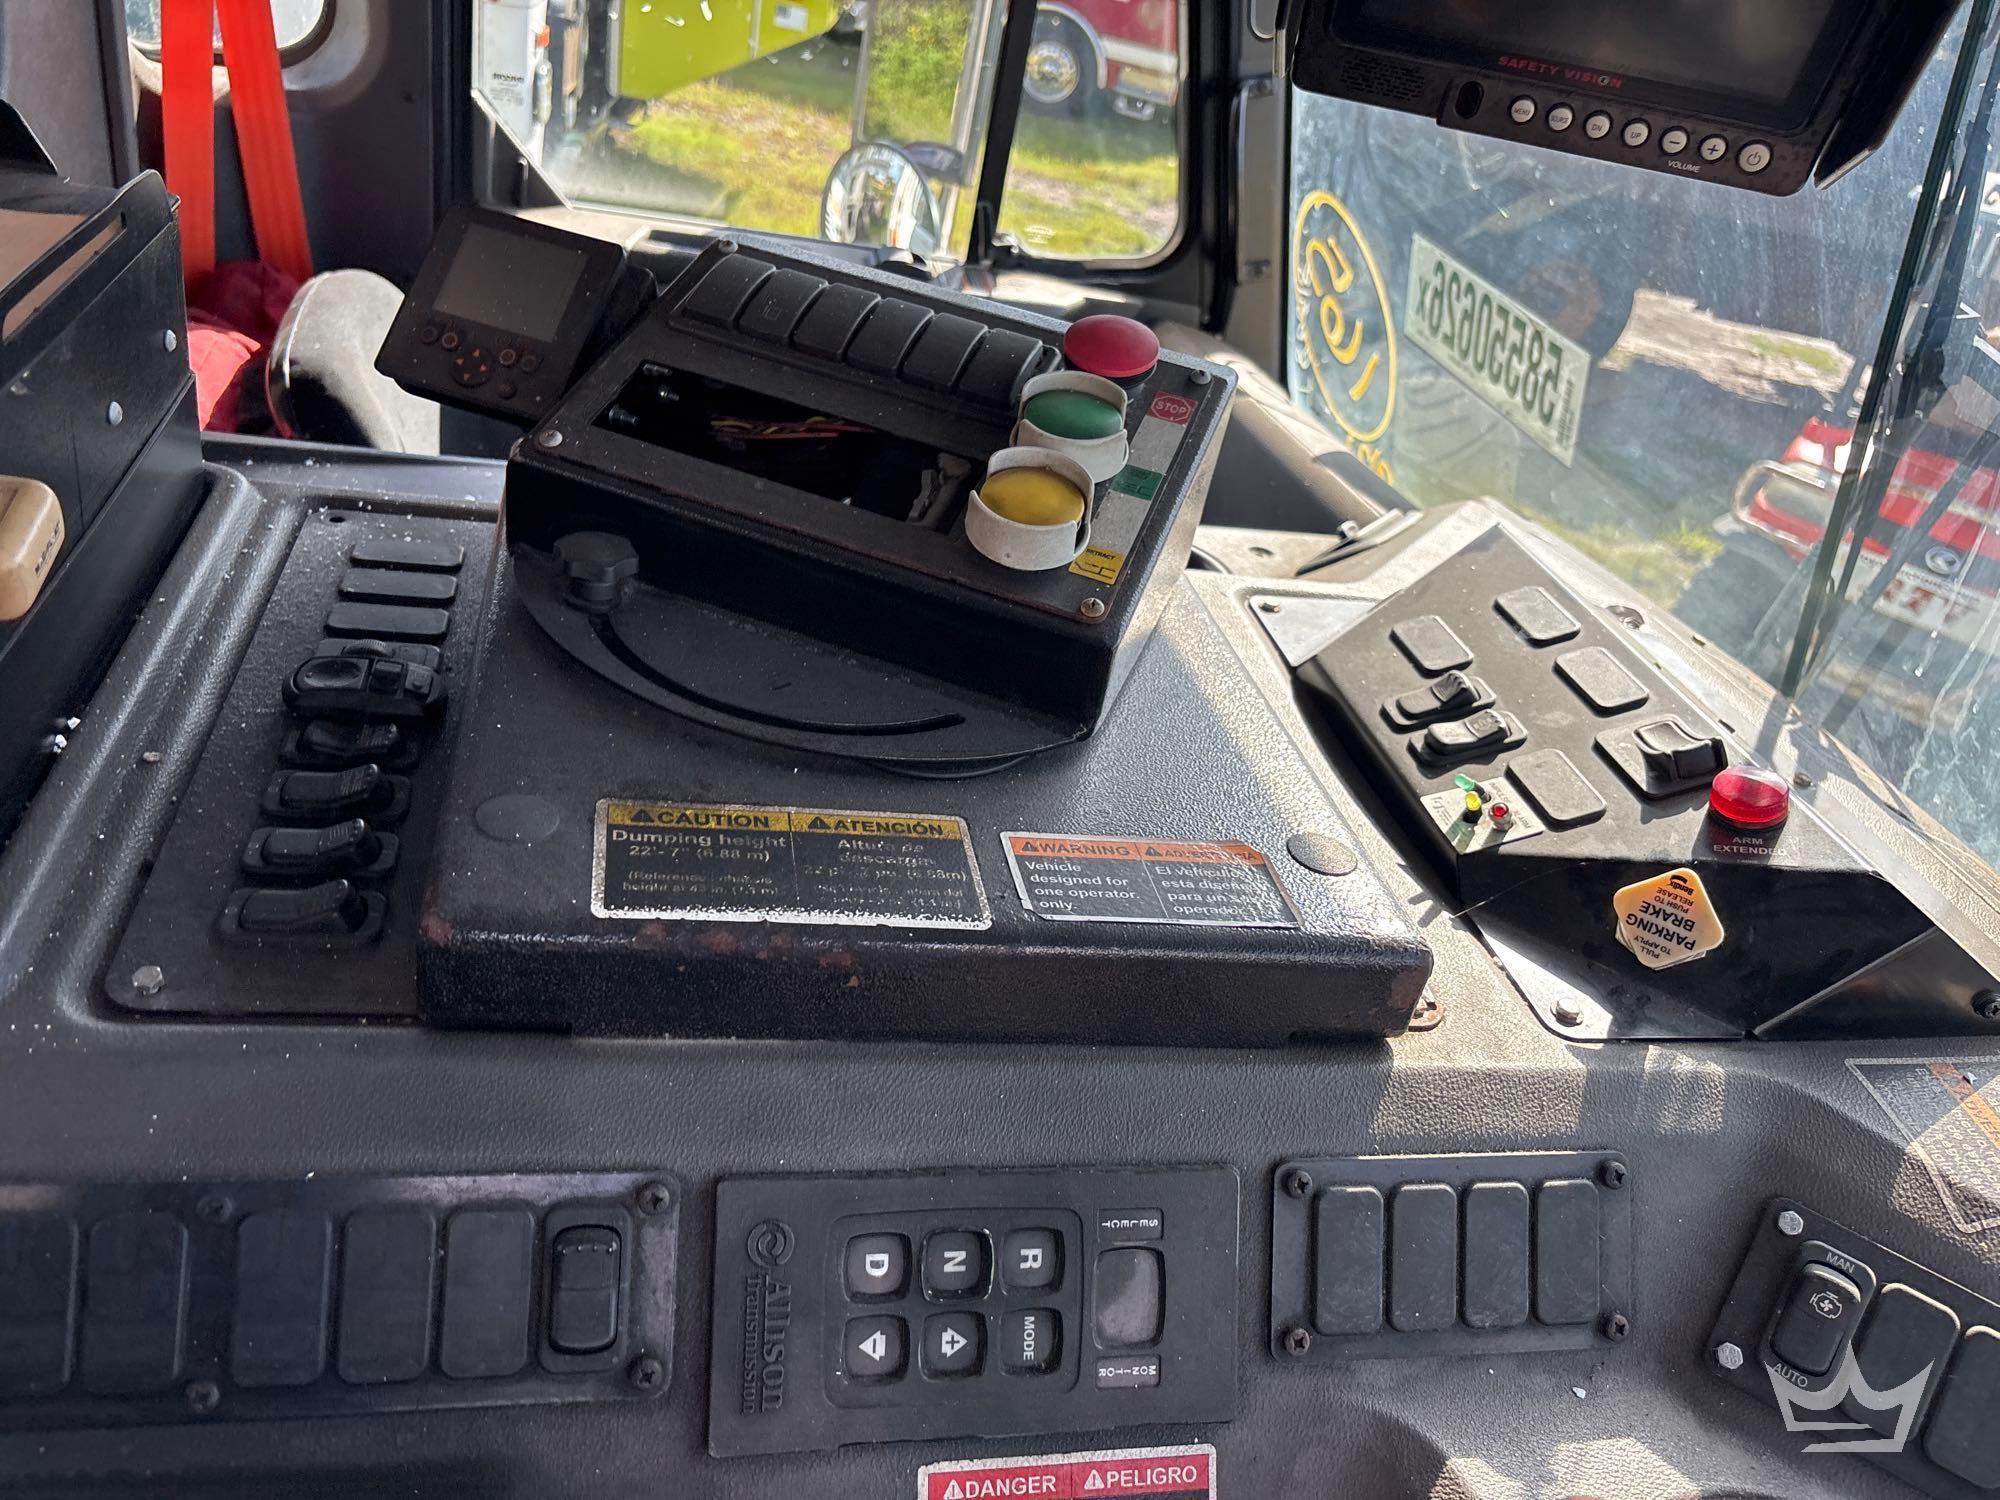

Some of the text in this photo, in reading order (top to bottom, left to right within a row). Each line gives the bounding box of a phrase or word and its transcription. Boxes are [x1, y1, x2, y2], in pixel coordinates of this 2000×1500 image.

[1498, 56, 1559, 75] SAFETY
[1513, 106, 1531, 116] MENU
[1630, 131, 1642, 139] UP
[1667, 159, 1700, 173] VOLUME
[1155, 401, 1187, 415] STOP
[657, 811, 770, 828] CAUTION
[834, 819, 943, 836] ATENCIÓN
[612, 829, 787, 848] Dumping height
[1732, 836, 1763, 845] ARM
[1038, 841, 1130, 857] WARNING
[1713, 844, 1788, 857] EXTENDED
[1025, 861, 1082, 872] Vehicle
[1155, 866, 1172, 875] El
[1030, 873, 1129, 887] designed for
[1666, 880, 1694, 896] Bendix
[1035, 886, 1141, 901] one operator.
[1167, 891, 1203, 903] para
[1655, 886, 1694, 907] RELEASE
[1039, 899, 1078, 912] only.
[1654, 895, 1689, 914] PUSH TO
[1639, 900, 1696, 932] BRAKE
[1625, 913, 1696, 951] PARKING
[1634, 935, 1671, 955] TO APPLY
[1640, 945, 1660, 959] PULL
[1101, 1219, 1159, 1228] SELECT
[865, 1252, 889, 1278] D
[943, 1250, 966, 1273] N
[1019, 1248, 1043, 1269] R
[1825, 1252, 1855, 1274] MAN
[742, 1276, 761, 1414] Transmission
[761, 1276, 792, 1411] Allison
[1023, 1315, 1035, 1361] MODE
[1098, 1365, 1156, 1377] MONITOR
[1773, 1362, 1808, 1388] AUTO
[1106, 1465, 1197, 1489] PELIGRO
[965, 1475, 1056, 1499] DANGER
